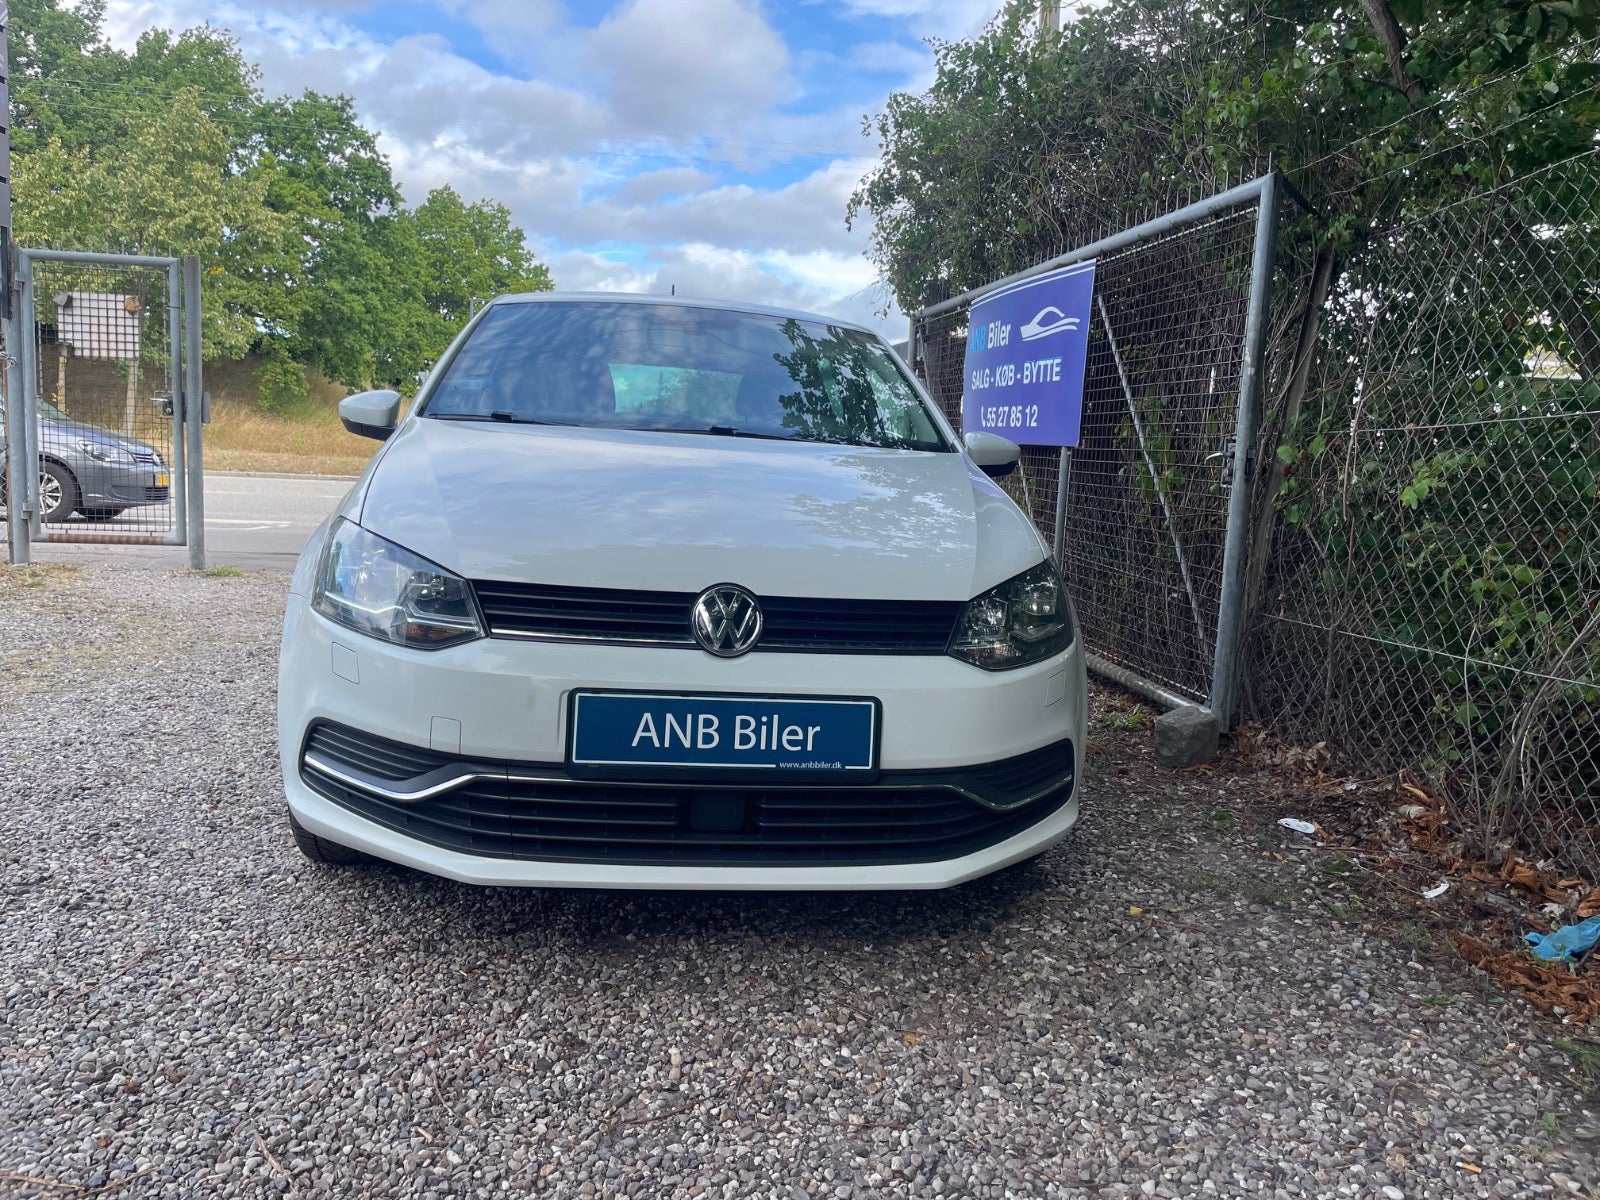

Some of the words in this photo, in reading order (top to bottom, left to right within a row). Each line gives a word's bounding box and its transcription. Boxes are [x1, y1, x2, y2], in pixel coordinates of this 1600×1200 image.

[987, 320, 1011, 349] Biler
[971, 367, 990, 390] SALG
[995, 364, 1015, 387] KØB
[1023, 358, 1062, 384] BYTTE
[986, 406, 996, 428] 55
[997, 406, 1009, 427] 27
[1010, 405, 1022, 427] 85
[1025, 404, 1038, 427] 12
[631, 712, 720, 749] ANB
[733, 714, 821, 751] Biler
[779, 760, 842, 769] www.anbbiler.dk
